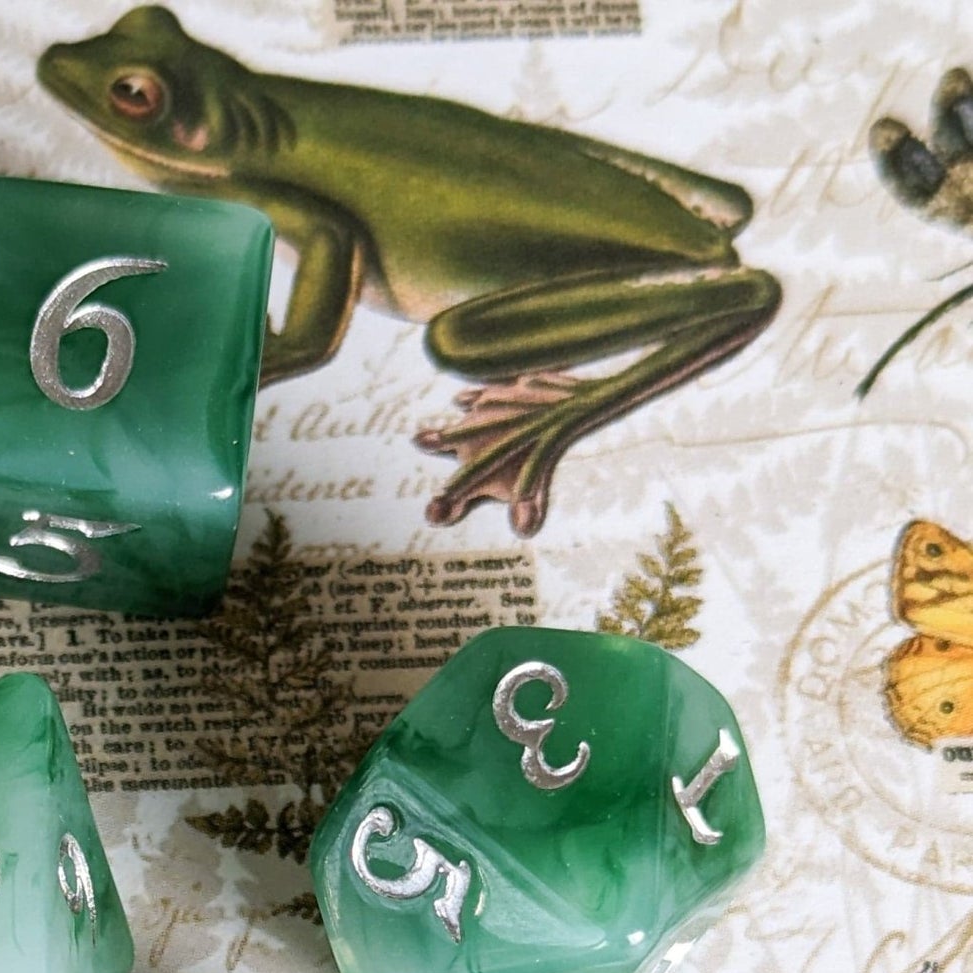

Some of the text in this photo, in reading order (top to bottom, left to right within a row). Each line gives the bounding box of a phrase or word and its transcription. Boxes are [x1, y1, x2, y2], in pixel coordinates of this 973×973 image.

[30, 257, 168, 411] 6
[493, 661, 590, 790] 3
[672, 728, 741, 845] 1
[350, 805, 471, 944] 5
